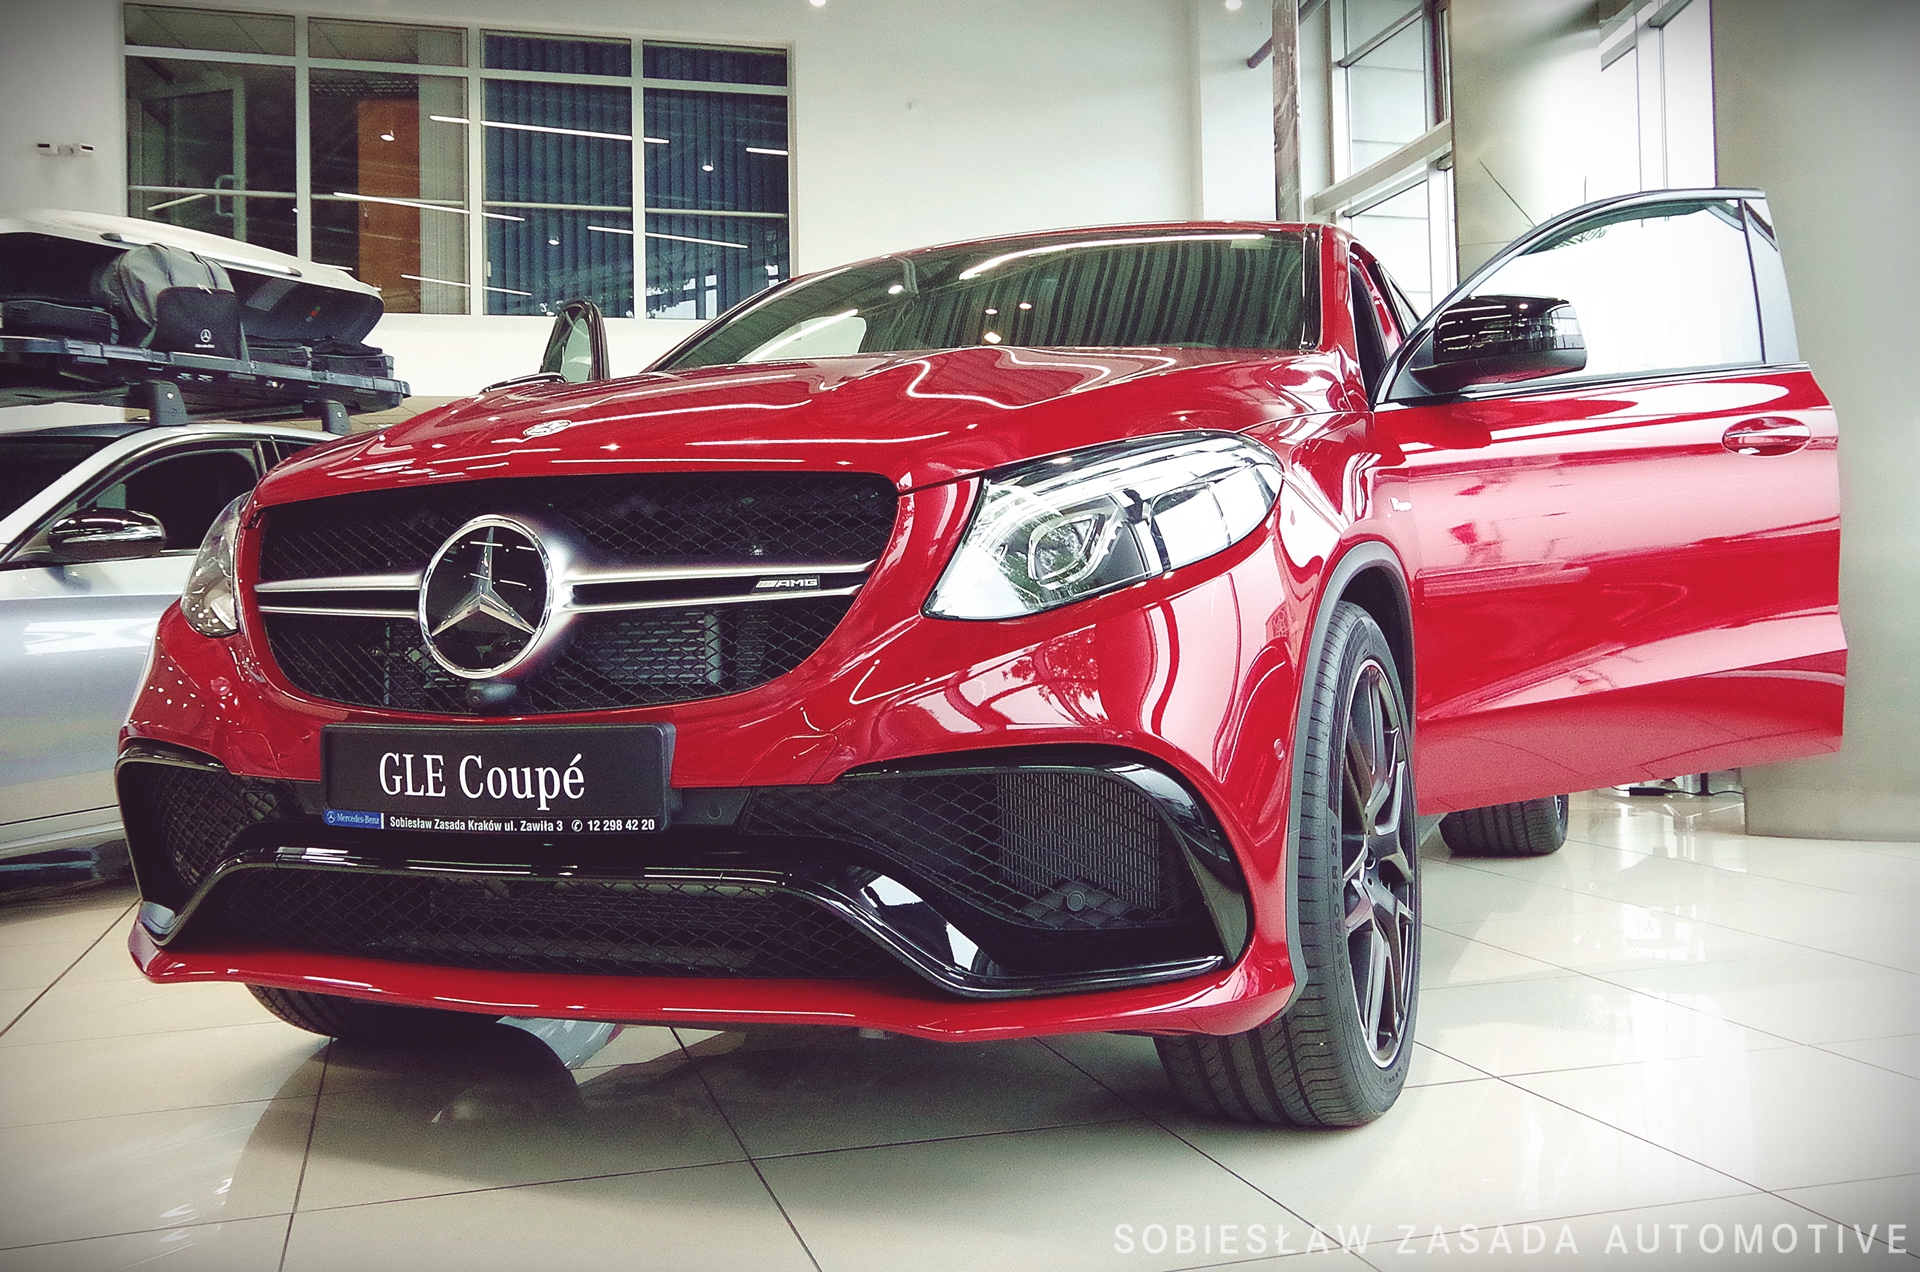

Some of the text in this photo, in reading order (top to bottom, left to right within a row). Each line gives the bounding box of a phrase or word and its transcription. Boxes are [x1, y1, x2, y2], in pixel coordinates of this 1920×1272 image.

[379, 752, 586, 812] GLE Coupé
[336, 812, 380, 825] Mercedes-Benz
[389, 816, 656, 832] Sobiesław Zasada Kraków ul. Zawiła 3 12 298 42 20
